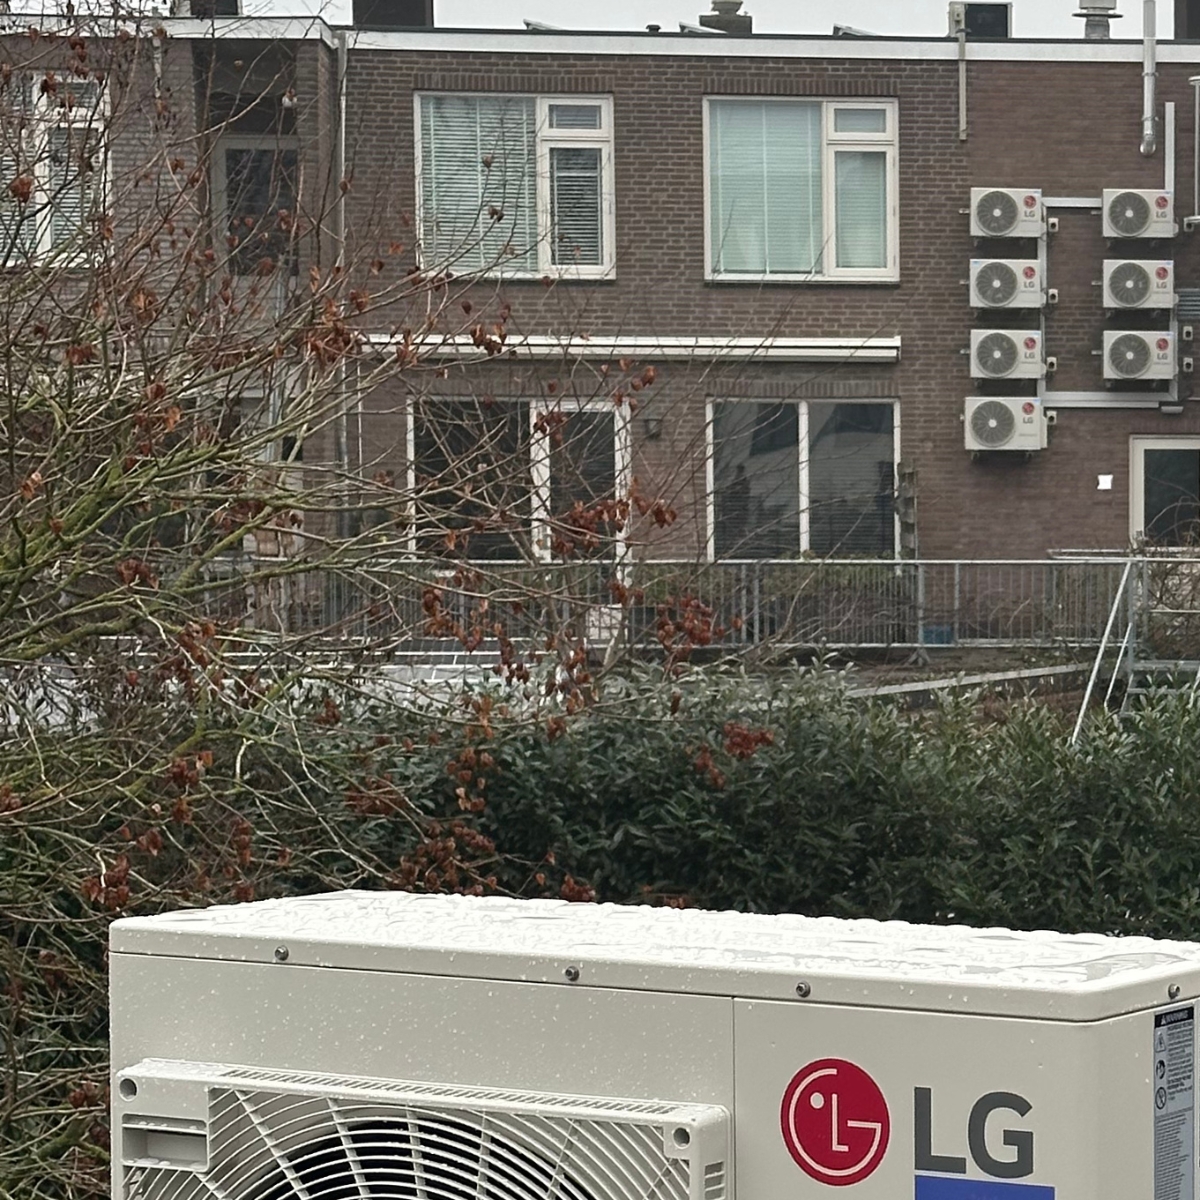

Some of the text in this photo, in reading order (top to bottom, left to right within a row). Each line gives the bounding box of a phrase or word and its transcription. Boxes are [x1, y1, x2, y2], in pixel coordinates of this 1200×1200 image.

[1024, 210, 1036, 218] LG
[1156, 281, 1168, 289] LG
[1024, 351, 1036, 359] LG
[1156, 352, 1168, 360] LG
[1022, 416, 1034, 424] LG
[914, 1086, 1034, 1179] LG
